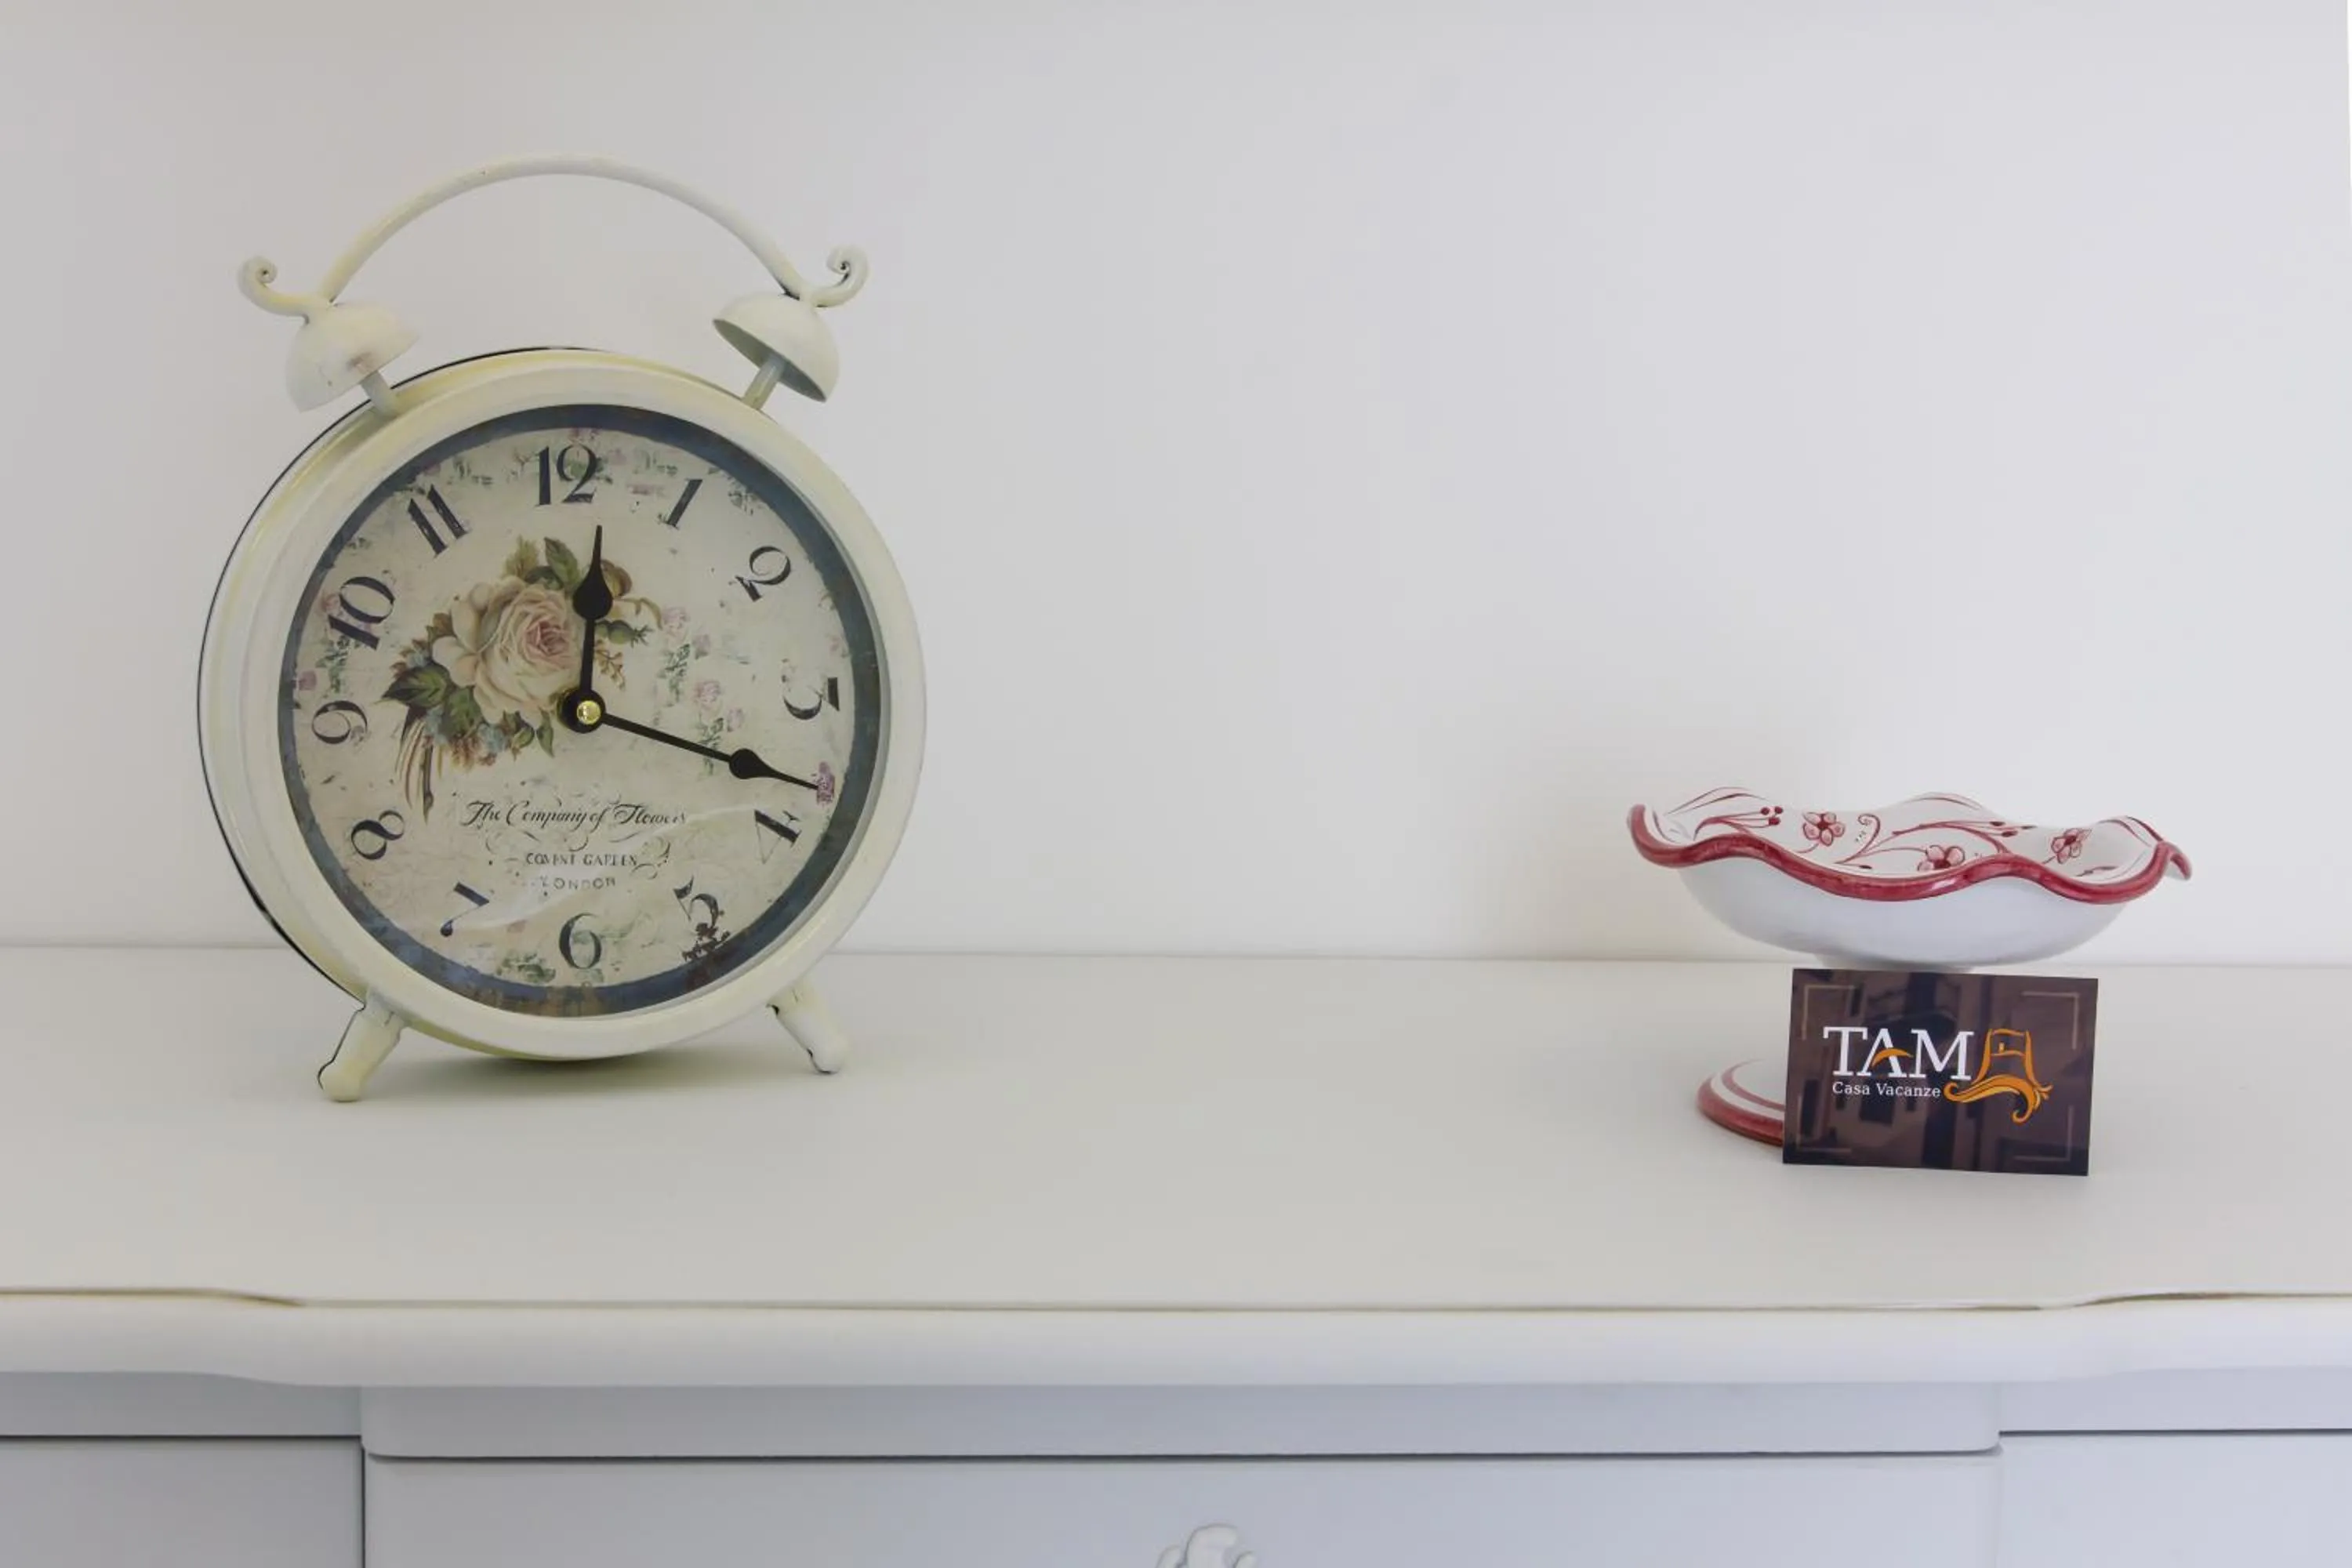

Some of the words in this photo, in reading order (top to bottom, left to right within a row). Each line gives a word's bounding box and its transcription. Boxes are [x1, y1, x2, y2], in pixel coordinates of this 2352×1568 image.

[535, 444, 597, 506] 12
[406, 483, 469, 558] 11
[659, 477, 703, 530] 1
[735, 546, 791, 602] 2
[326, 575, 397, 651] 10
[311, 700, 368, 745] 9
[350, 810, 405, 860] 8
[461, 800, 500, 829] The
[506, 800, 588, 833] Company
[590, 806, 609, 834] of
[753, 808, 802, 865] 4
[439, 882, 490, 937] 7
[673, 876, 729, 933] 5
[559, 912, 602, 971] 6
[1832, 1081, 1871, 1096] Casa
[1875, 1083, 1942, 1098] Vacanze
